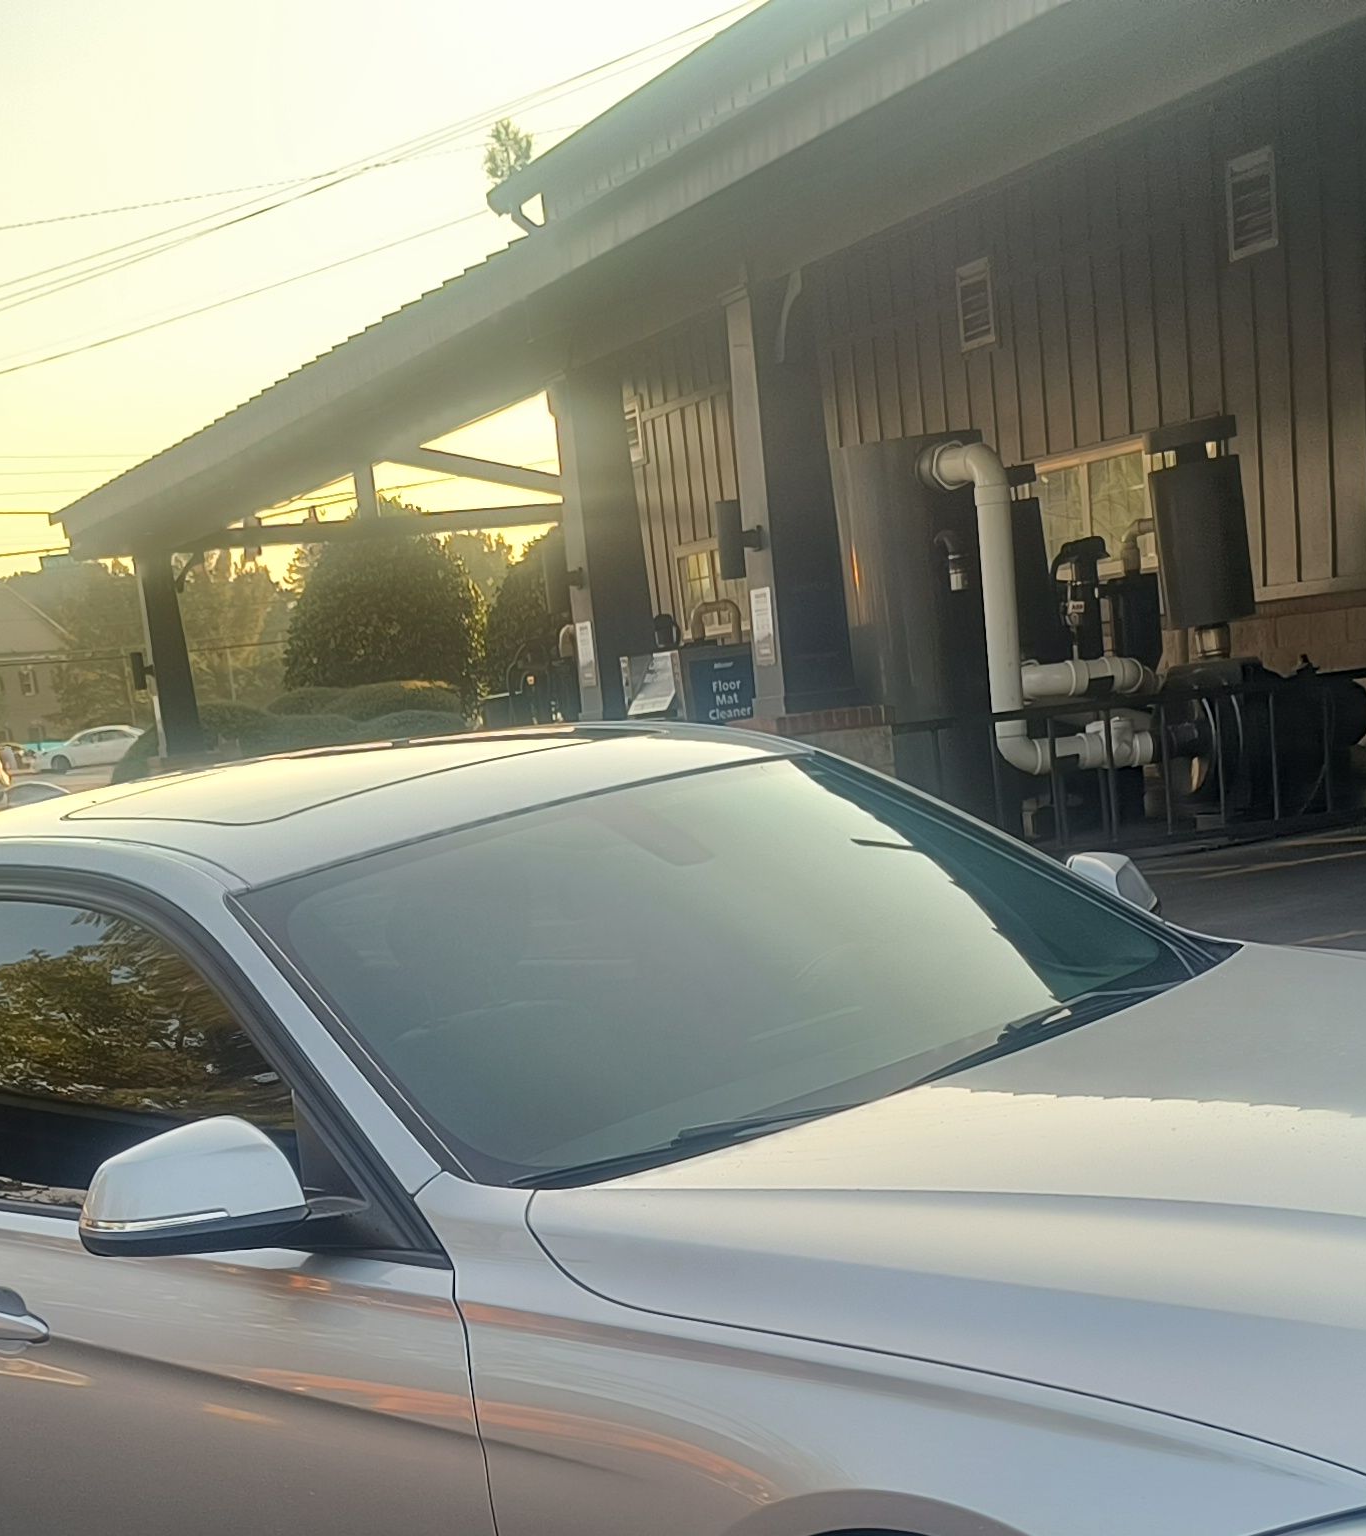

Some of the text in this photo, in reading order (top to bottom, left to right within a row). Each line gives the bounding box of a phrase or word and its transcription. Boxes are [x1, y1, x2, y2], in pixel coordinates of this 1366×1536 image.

[712, 678, 742, 693] Floor
[715, 692, 740, 706] Mat
[708, 706, 752, 721] Cleaner
